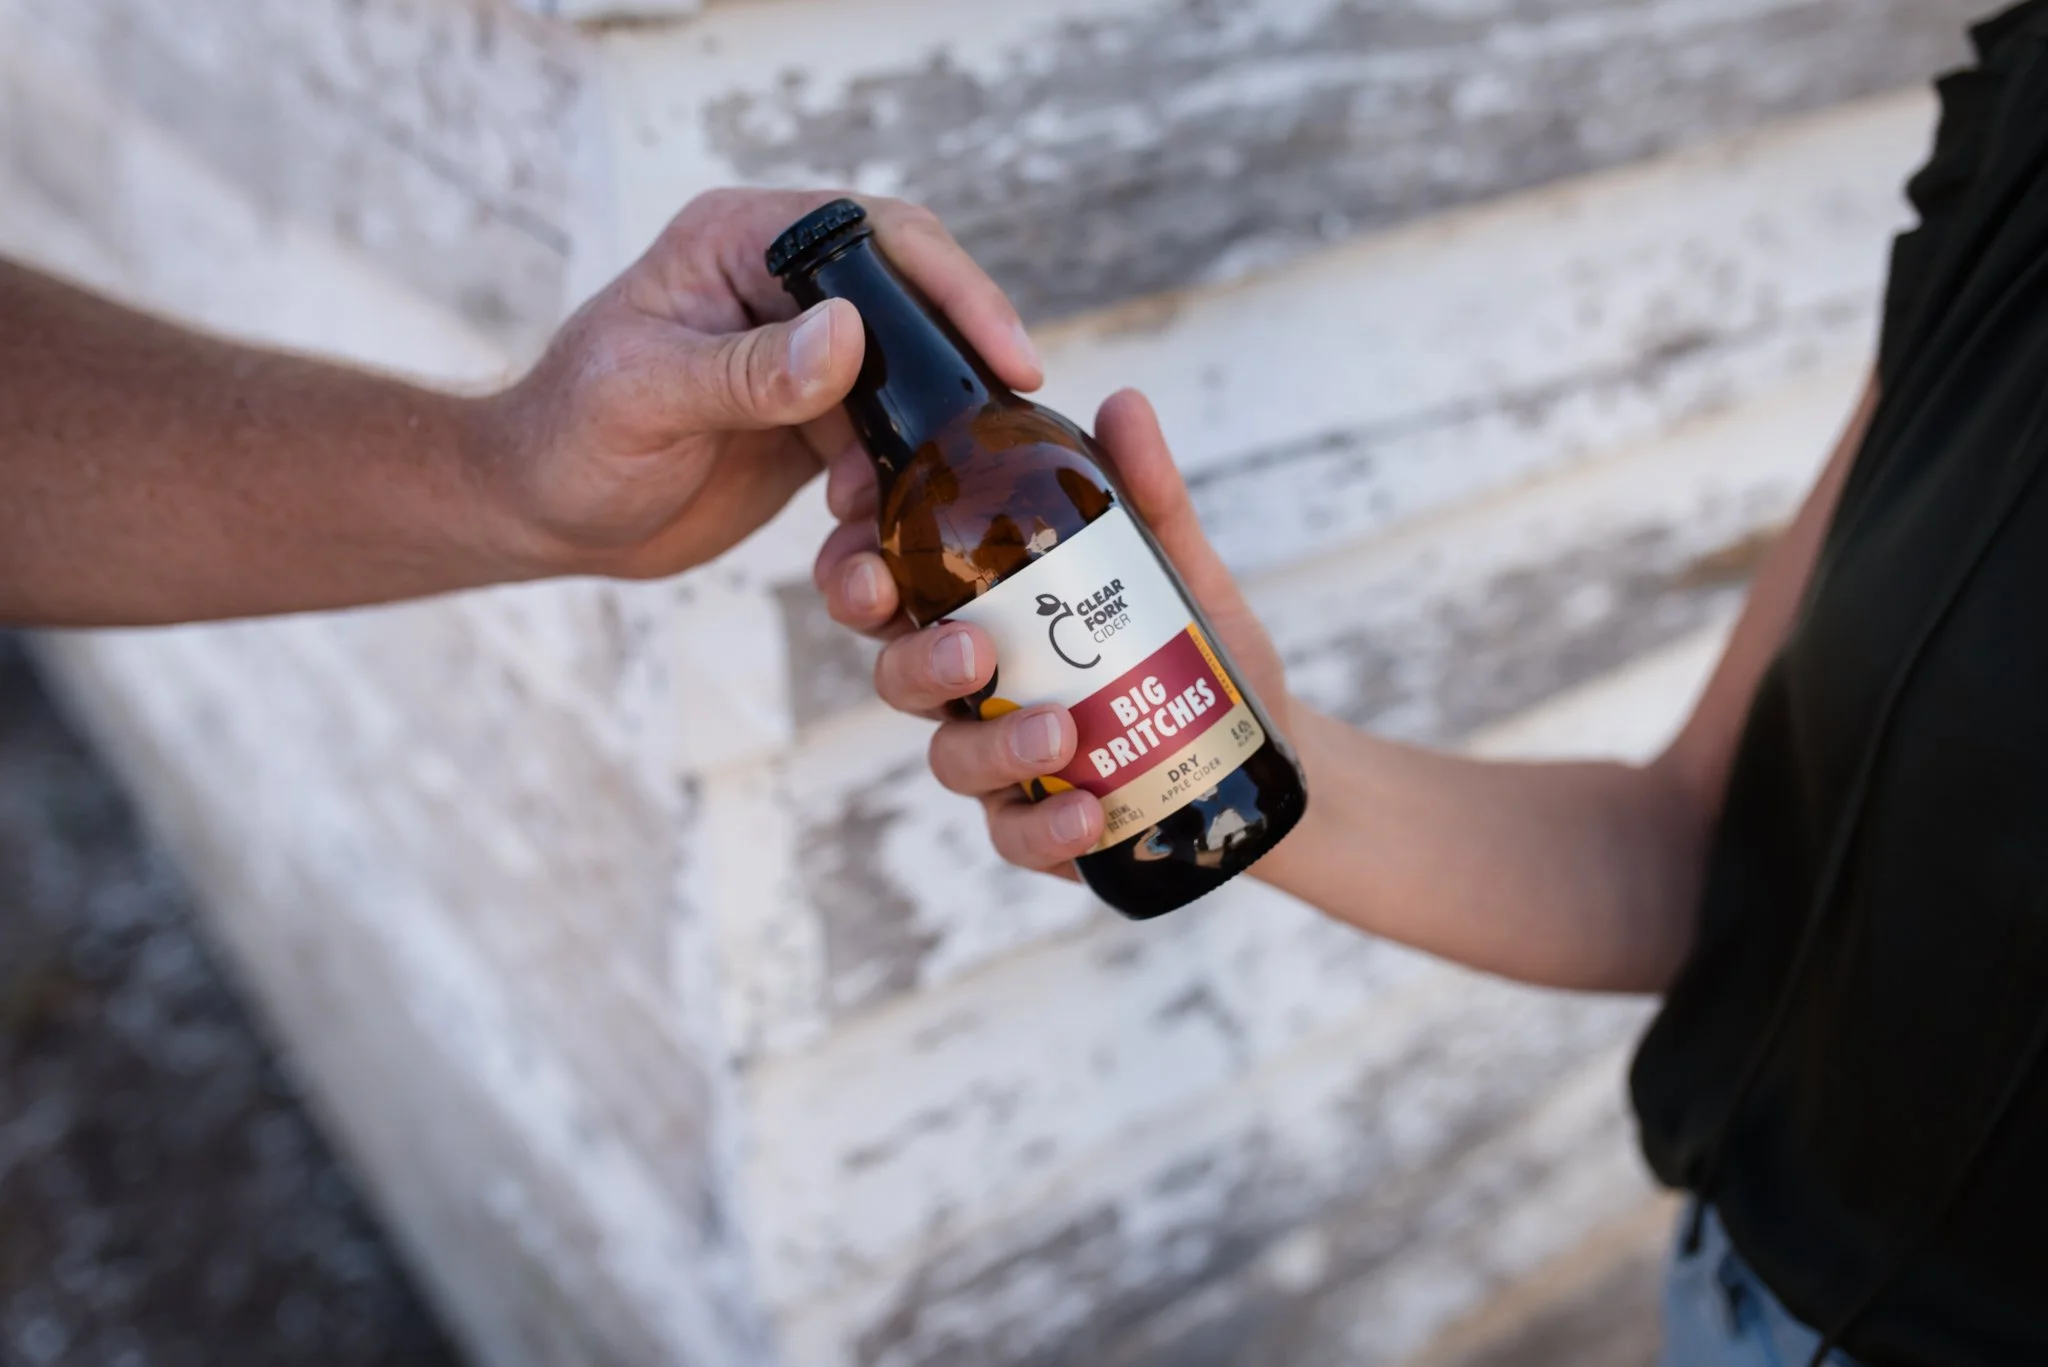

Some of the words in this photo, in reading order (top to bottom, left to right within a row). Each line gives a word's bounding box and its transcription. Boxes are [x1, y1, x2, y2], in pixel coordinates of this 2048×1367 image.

[1076, 578, 1125, 616] CLEAR
[1084, 595, 1128, 632] FORK
[1093, 613, 1131, 643] CIDER
[1109, 676, 1167, 727] BIG
[1088, 677, 1216, 778] BRITCHES
[1161, 779, 1191, 803] APPLE
[1192, 757, 1221, 781] CIDER
[1167, 753, 1199, 783] DRY
